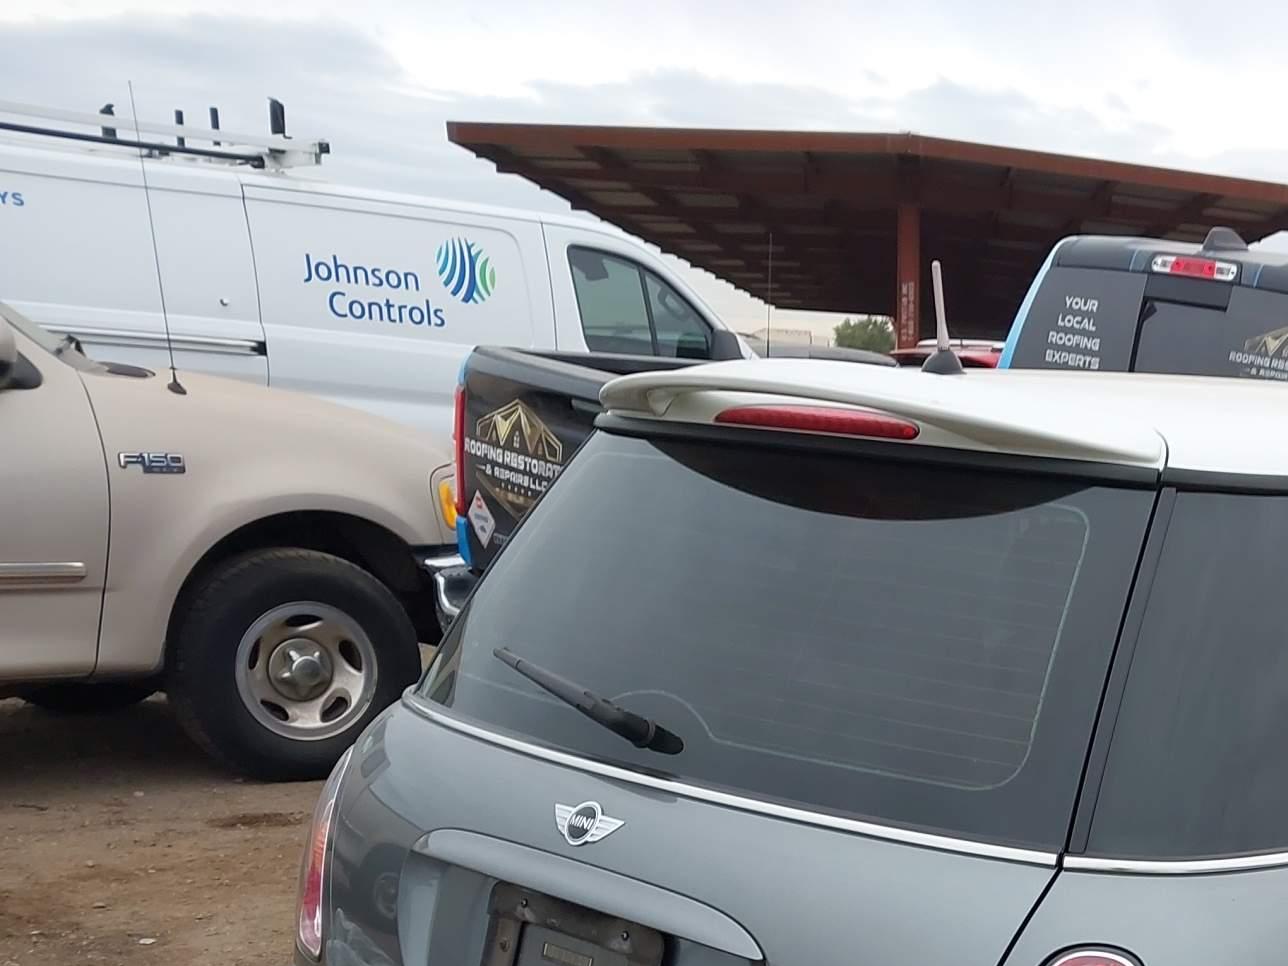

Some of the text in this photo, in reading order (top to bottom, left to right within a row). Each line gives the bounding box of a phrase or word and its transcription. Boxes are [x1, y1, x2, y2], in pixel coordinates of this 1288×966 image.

[303, 253, 420, 291] Johnson
[328, 291, 446, 328] Controls
[1065, 295, 1099, 313] YOUR
[1057, 312, 1097, 332] LOCAL
[1047, 330, 1101, 351] ROOFING
[1045, 349, 1100, 370] EXPERTS
[1229, 351, 1271, 371] ROOFING
[464, 438, 503, 462] ROOFING
[569, 814, 595, 830] MINI
